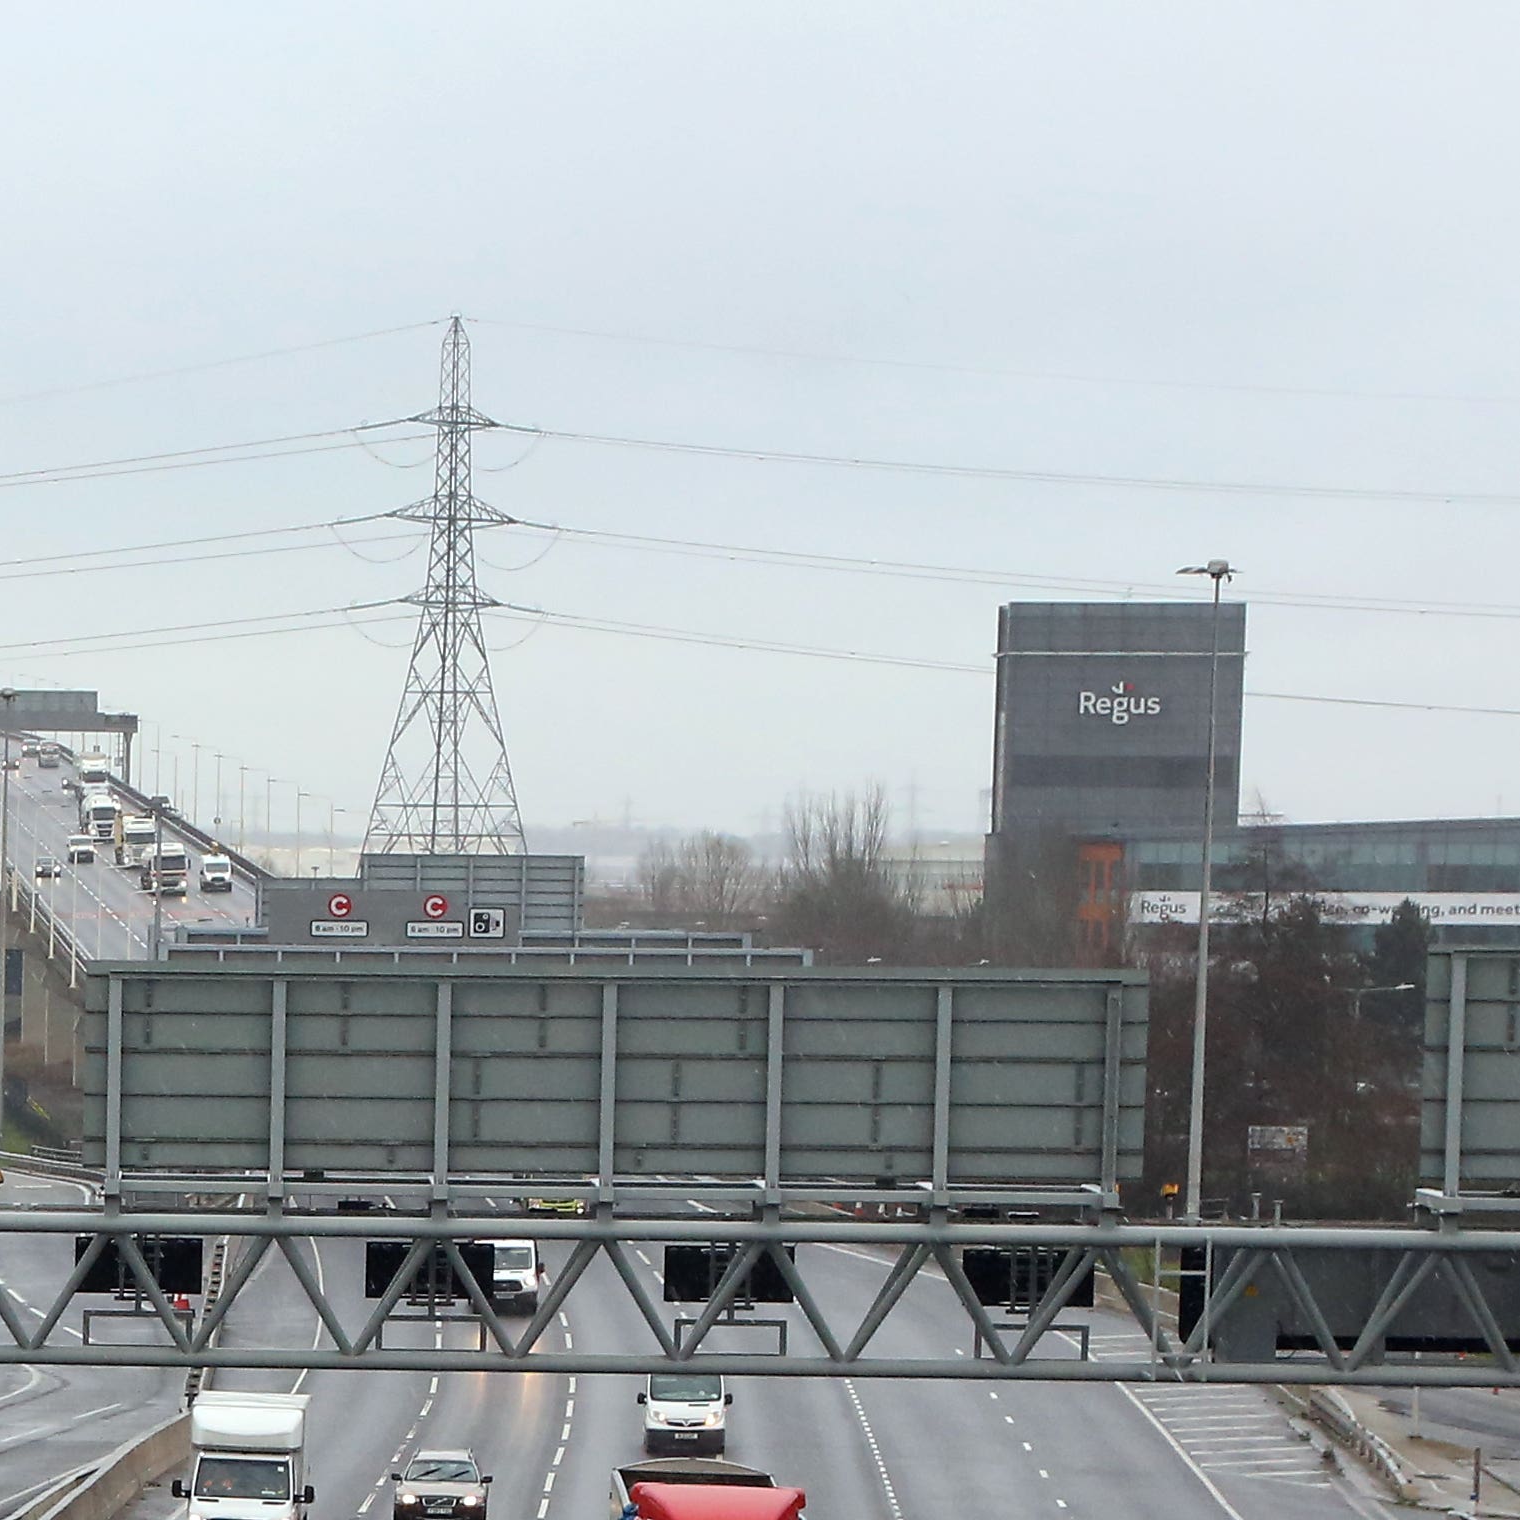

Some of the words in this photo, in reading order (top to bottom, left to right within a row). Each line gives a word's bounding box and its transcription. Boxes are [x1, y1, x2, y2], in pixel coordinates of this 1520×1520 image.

[1079, 691, 1160, 724] Regus
[1141, 901, 1187, 921] Regus
[1449, 903, 1477, 915] and
